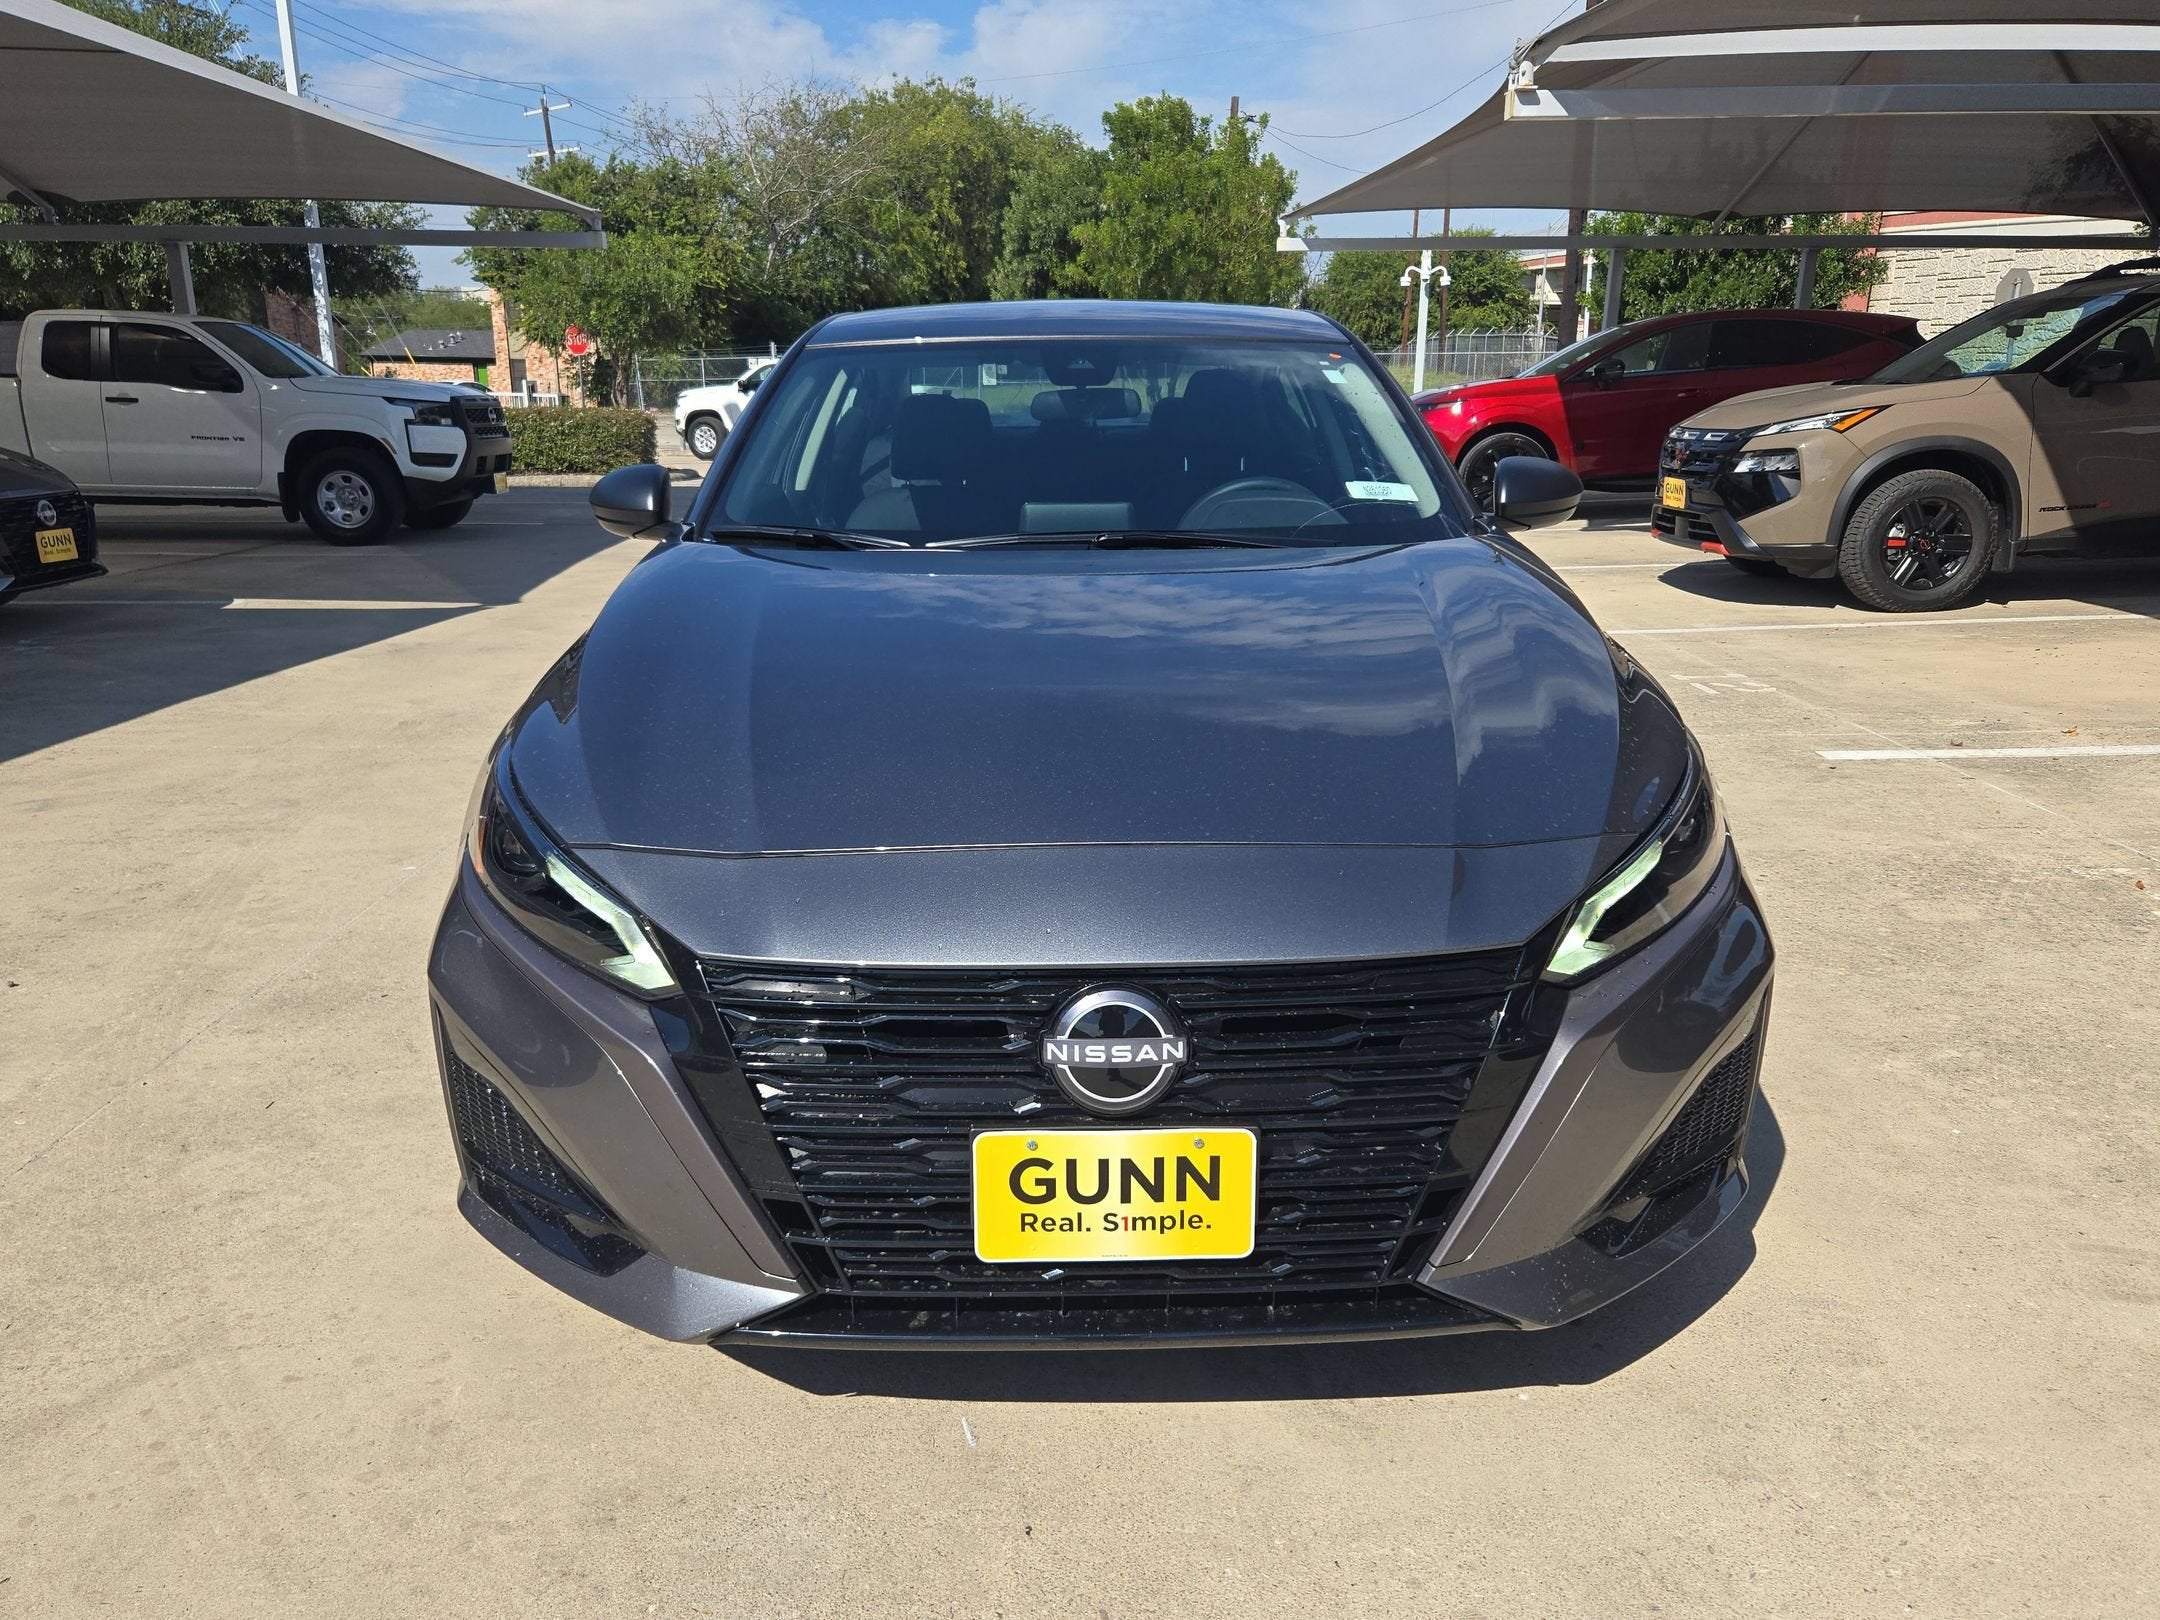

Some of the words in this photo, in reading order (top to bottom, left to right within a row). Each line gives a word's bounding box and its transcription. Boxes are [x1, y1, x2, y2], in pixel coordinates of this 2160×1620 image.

[1665, 482, 1684, 496] GUNN
[40, 534, 72, 549] GUNN
[1046, 1041, 1184, 1063] NISSAN
[1009, 1155, 1221, 1205] GUNN
[1020, 1212, 1091, 1233] Real.
